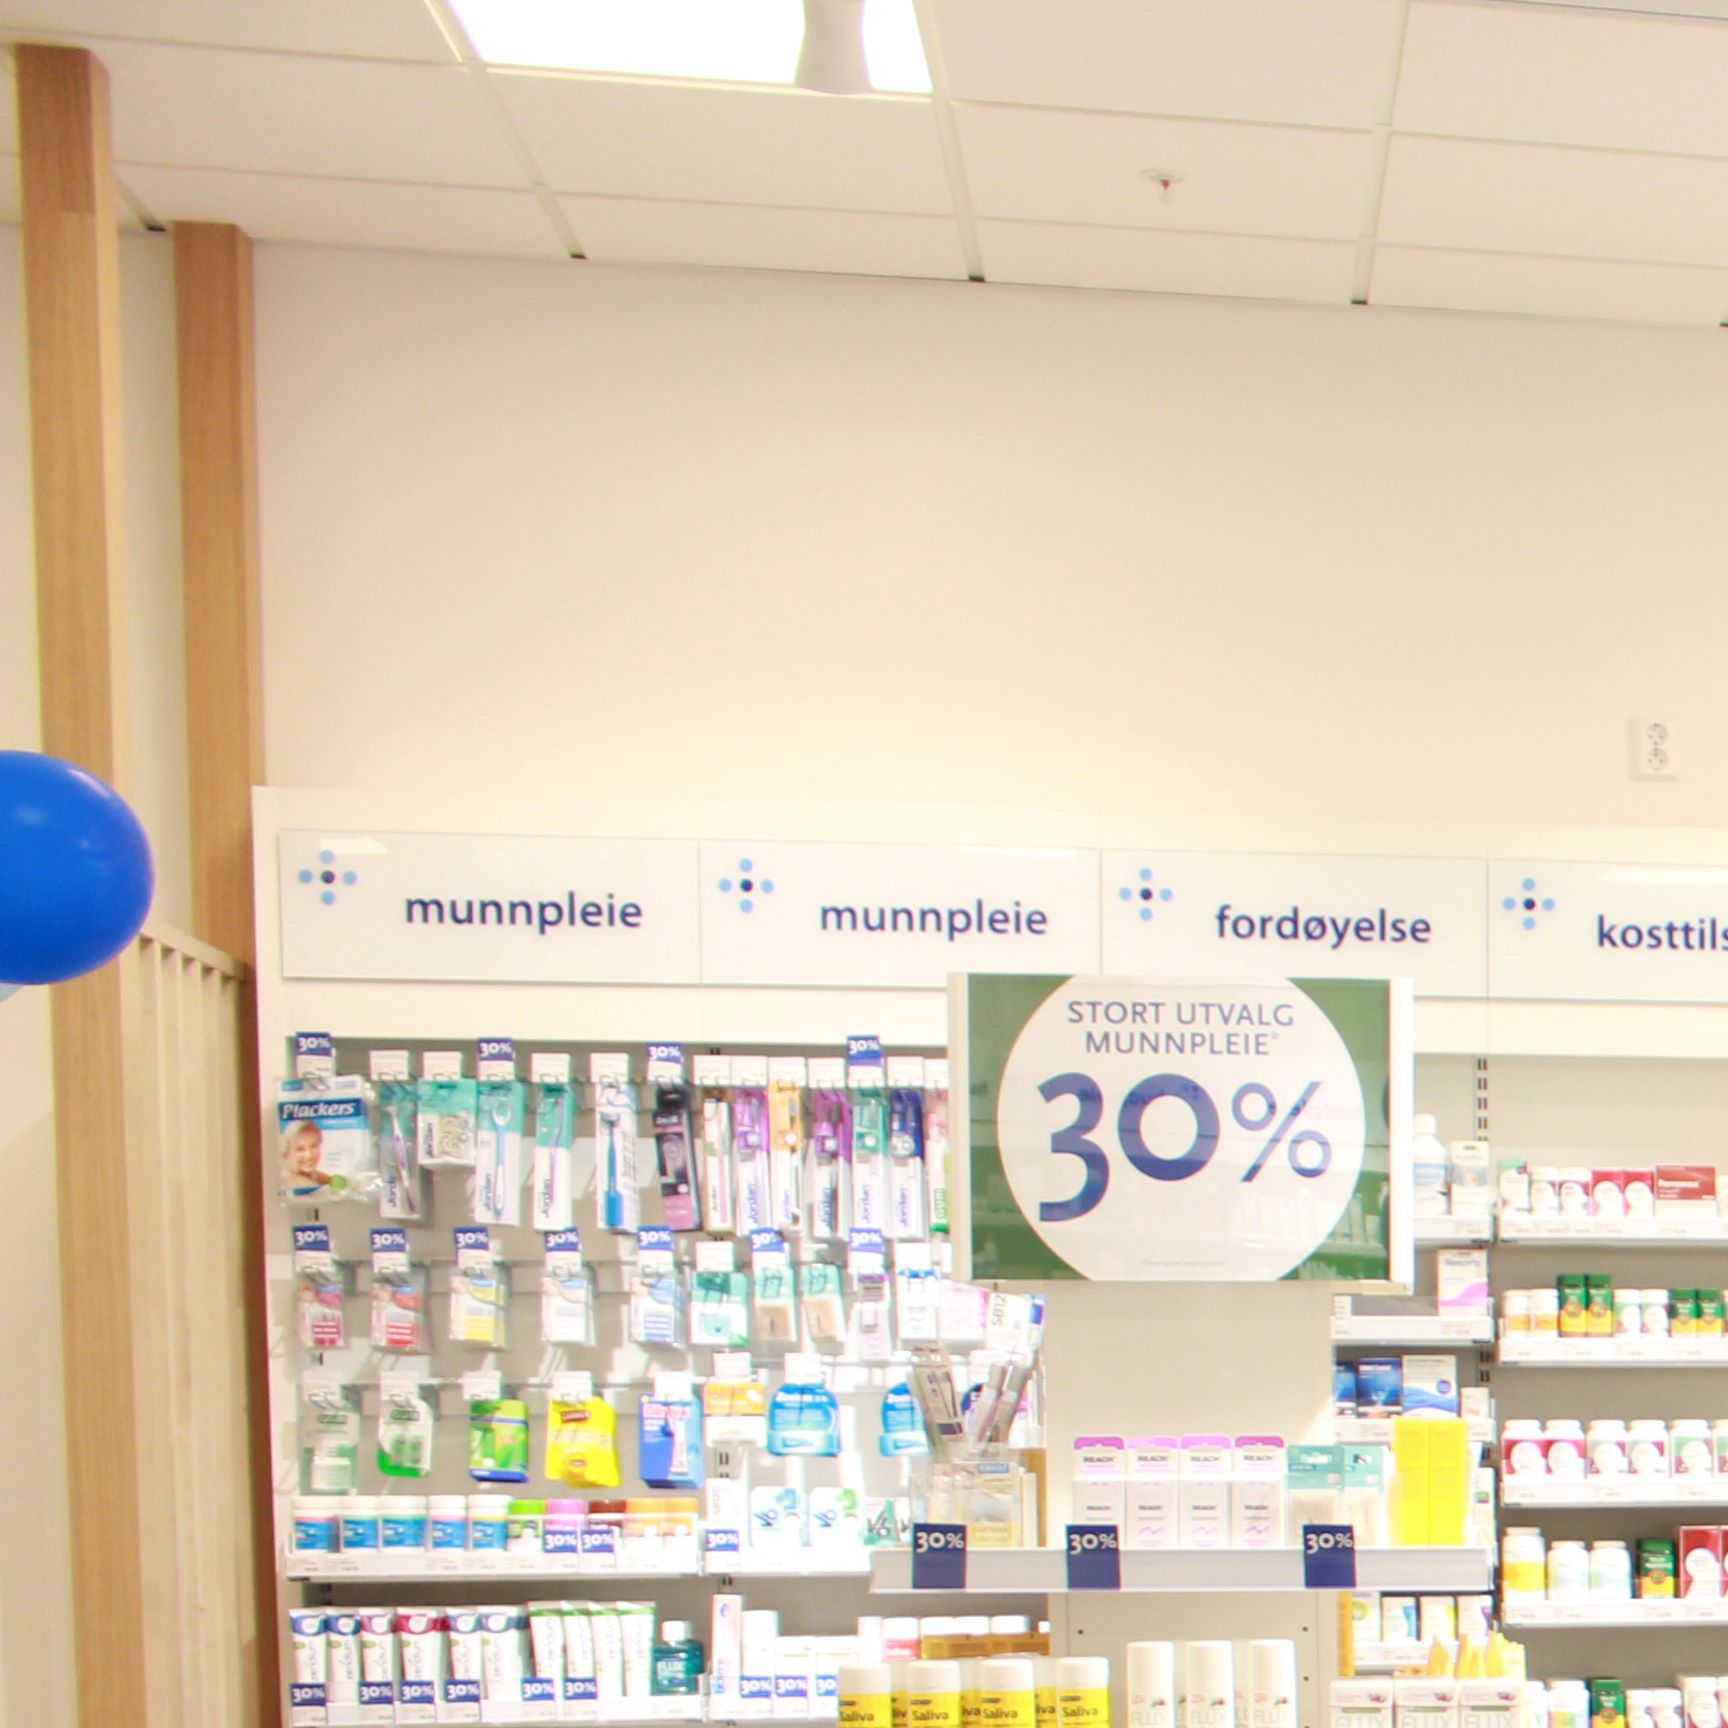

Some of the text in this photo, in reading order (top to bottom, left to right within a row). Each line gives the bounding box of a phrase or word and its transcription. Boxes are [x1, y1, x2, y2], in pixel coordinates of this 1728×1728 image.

[405, 890, 643, 936] munnpleie
[820, 899, 1049, 942] munnpleie
[1215, 903, 1432, 949] fordøyelse
[1068, 1000, 1294, 1026] STORT UTVALG
[298, 1037, 330, 1050] 30%
[649, 1046, 681, 1059] 30%
[282, 1101, 356, 1118] Plackers
[1037, 1071, 1332, 1223] 30%
[372, 1233, 405, 1248] 30%
[546, 1231, 579, 1245] 30%
[851, 1232, 882, 1247] 30%
[992, 1295, 1006, 1327] SB12
[582, 1534, 613, 1549] 30%
[916, 1530, 964, 1552] 30%
[1070, 1533, 1117, 1554] 30%
[1307, 1533, 1353, 1554] 30%
[292, 1687, 324, 1702] 30%
[448, 1684, 479, 1699] 30%
[565, 1682, 596, 1696] 30%
[912, 1710, 949, 1722] Saliva
[982, 1708, 1018, 1720] Saliva
[1062, 1706, 1098, 1718] Saliva
